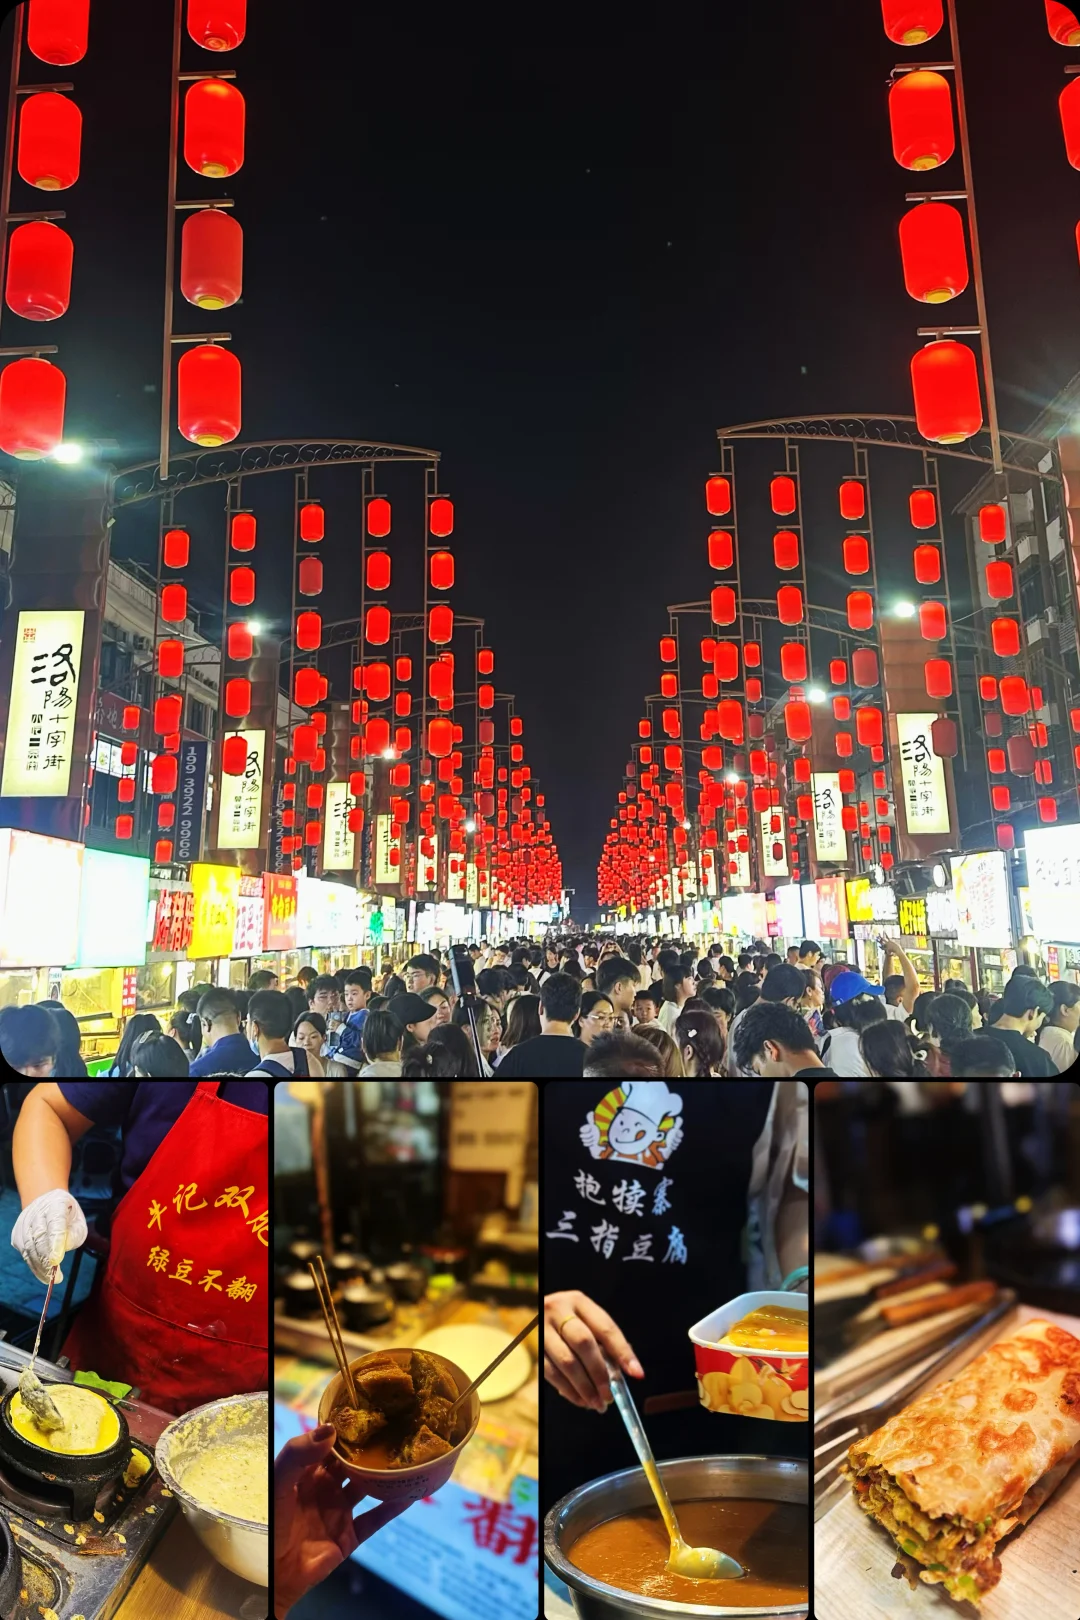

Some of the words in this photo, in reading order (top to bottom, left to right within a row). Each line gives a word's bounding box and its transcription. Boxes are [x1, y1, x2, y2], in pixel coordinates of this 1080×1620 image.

[185, 746, 197, 774] 199
[180, 778, 195, 816] 3922
[178, 819, 192, 858] 9966
[573, 1169, 674, 1217] 抱犊寨
[545, 1211, 688, 1265] 三指豆腐
[146, 1245, 258, 1303] 绿豆不翻
